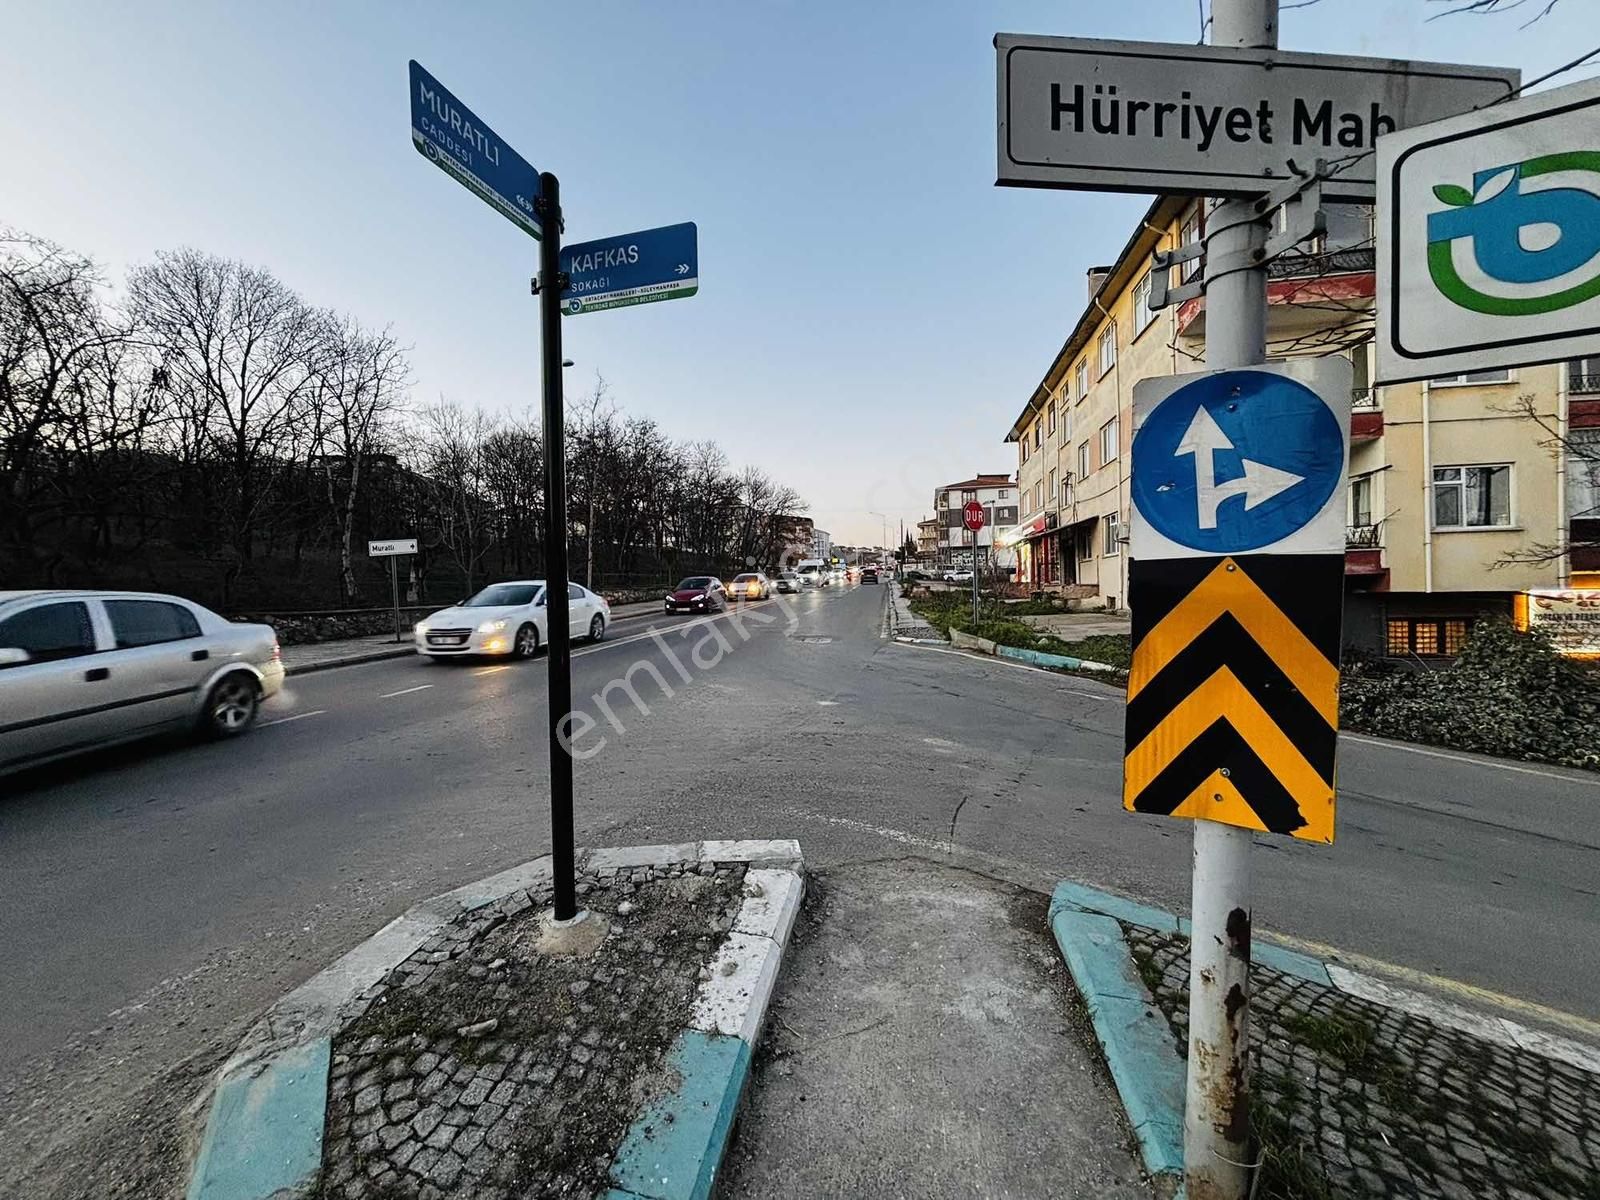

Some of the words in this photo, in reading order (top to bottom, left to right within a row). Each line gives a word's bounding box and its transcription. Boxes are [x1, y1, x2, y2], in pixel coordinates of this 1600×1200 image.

[420, 80, 500, 167] MURATLI
[1049, 82, 1275, 151] Hürriyet
[571, 245, 639, 274] KAFKAS
[966, 510, 984, 522] DUR
